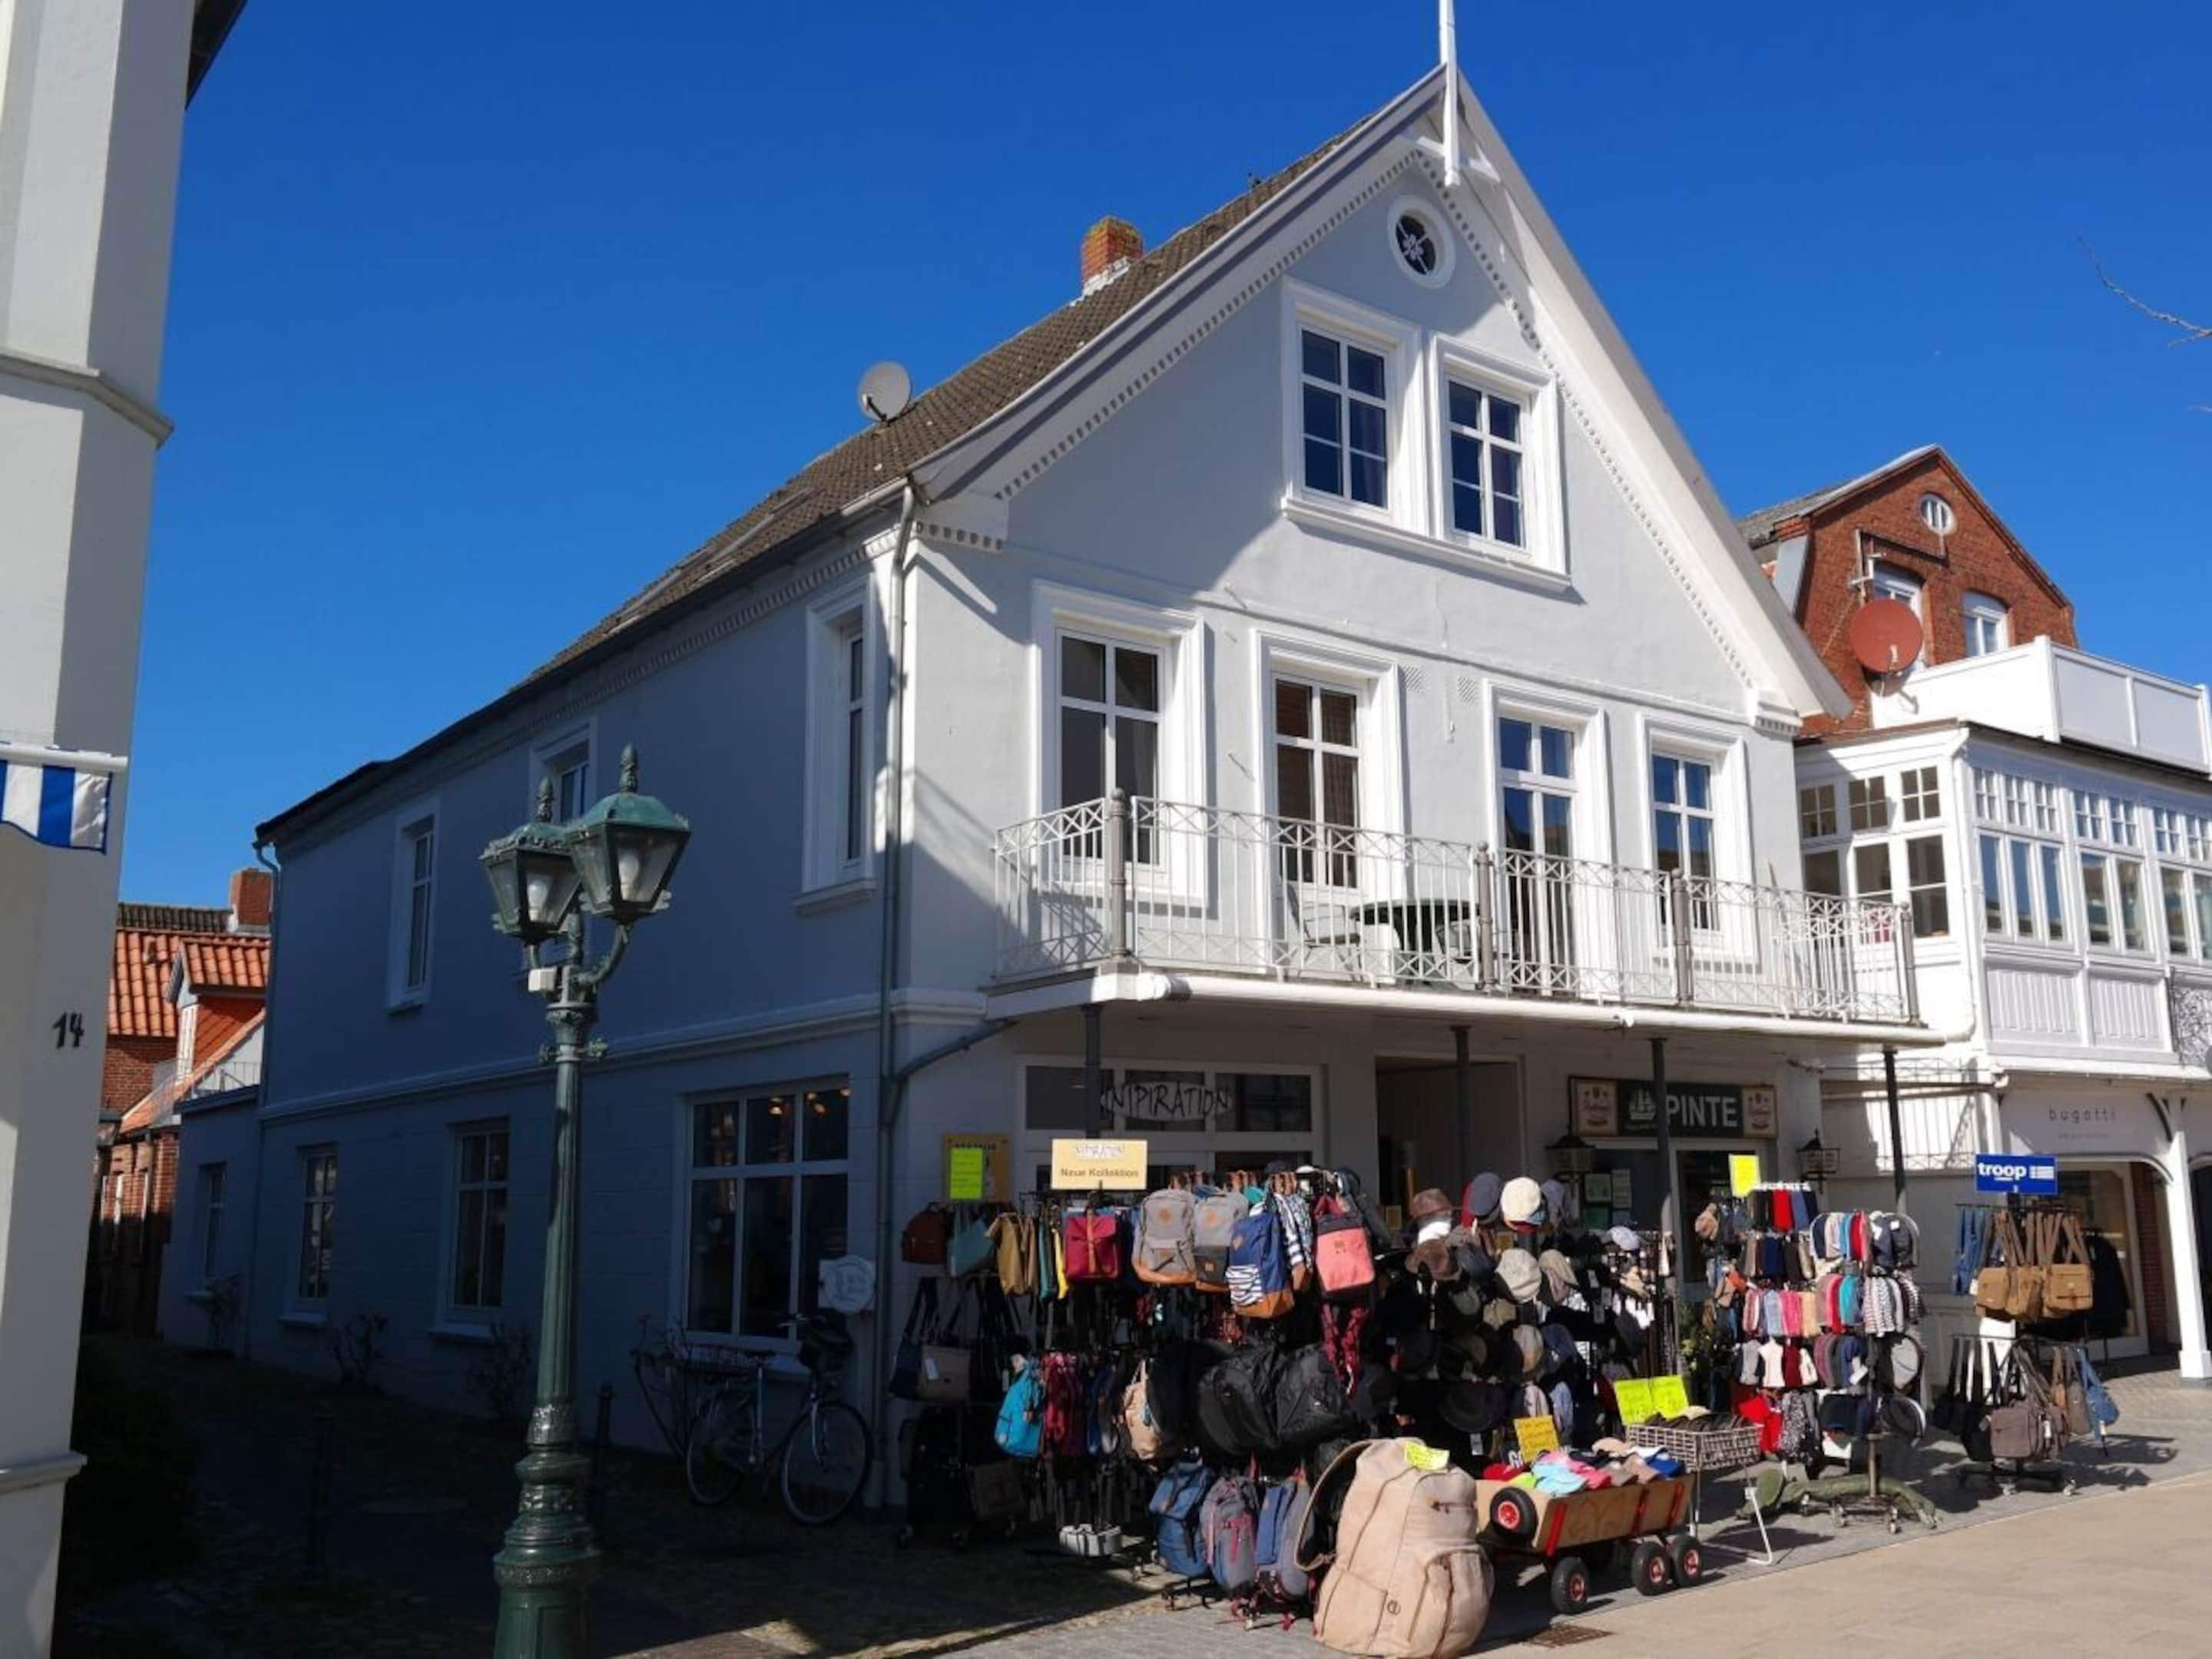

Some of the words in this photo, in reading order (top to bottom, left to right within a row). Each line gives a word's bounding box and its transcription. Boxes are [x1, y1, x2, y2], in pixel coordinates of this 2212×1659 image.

[52, 1011, 84, 1049] 14
[1664, 1093, 1738, 1128] PINTE
[2048, 1106, 2116, 1124] bugatti
[1060, 1167, 1087, 1177] Neue
[1088, 1167, 1139, 1178] Kollektion
[1977, 1162, 2028, 1181] troop
